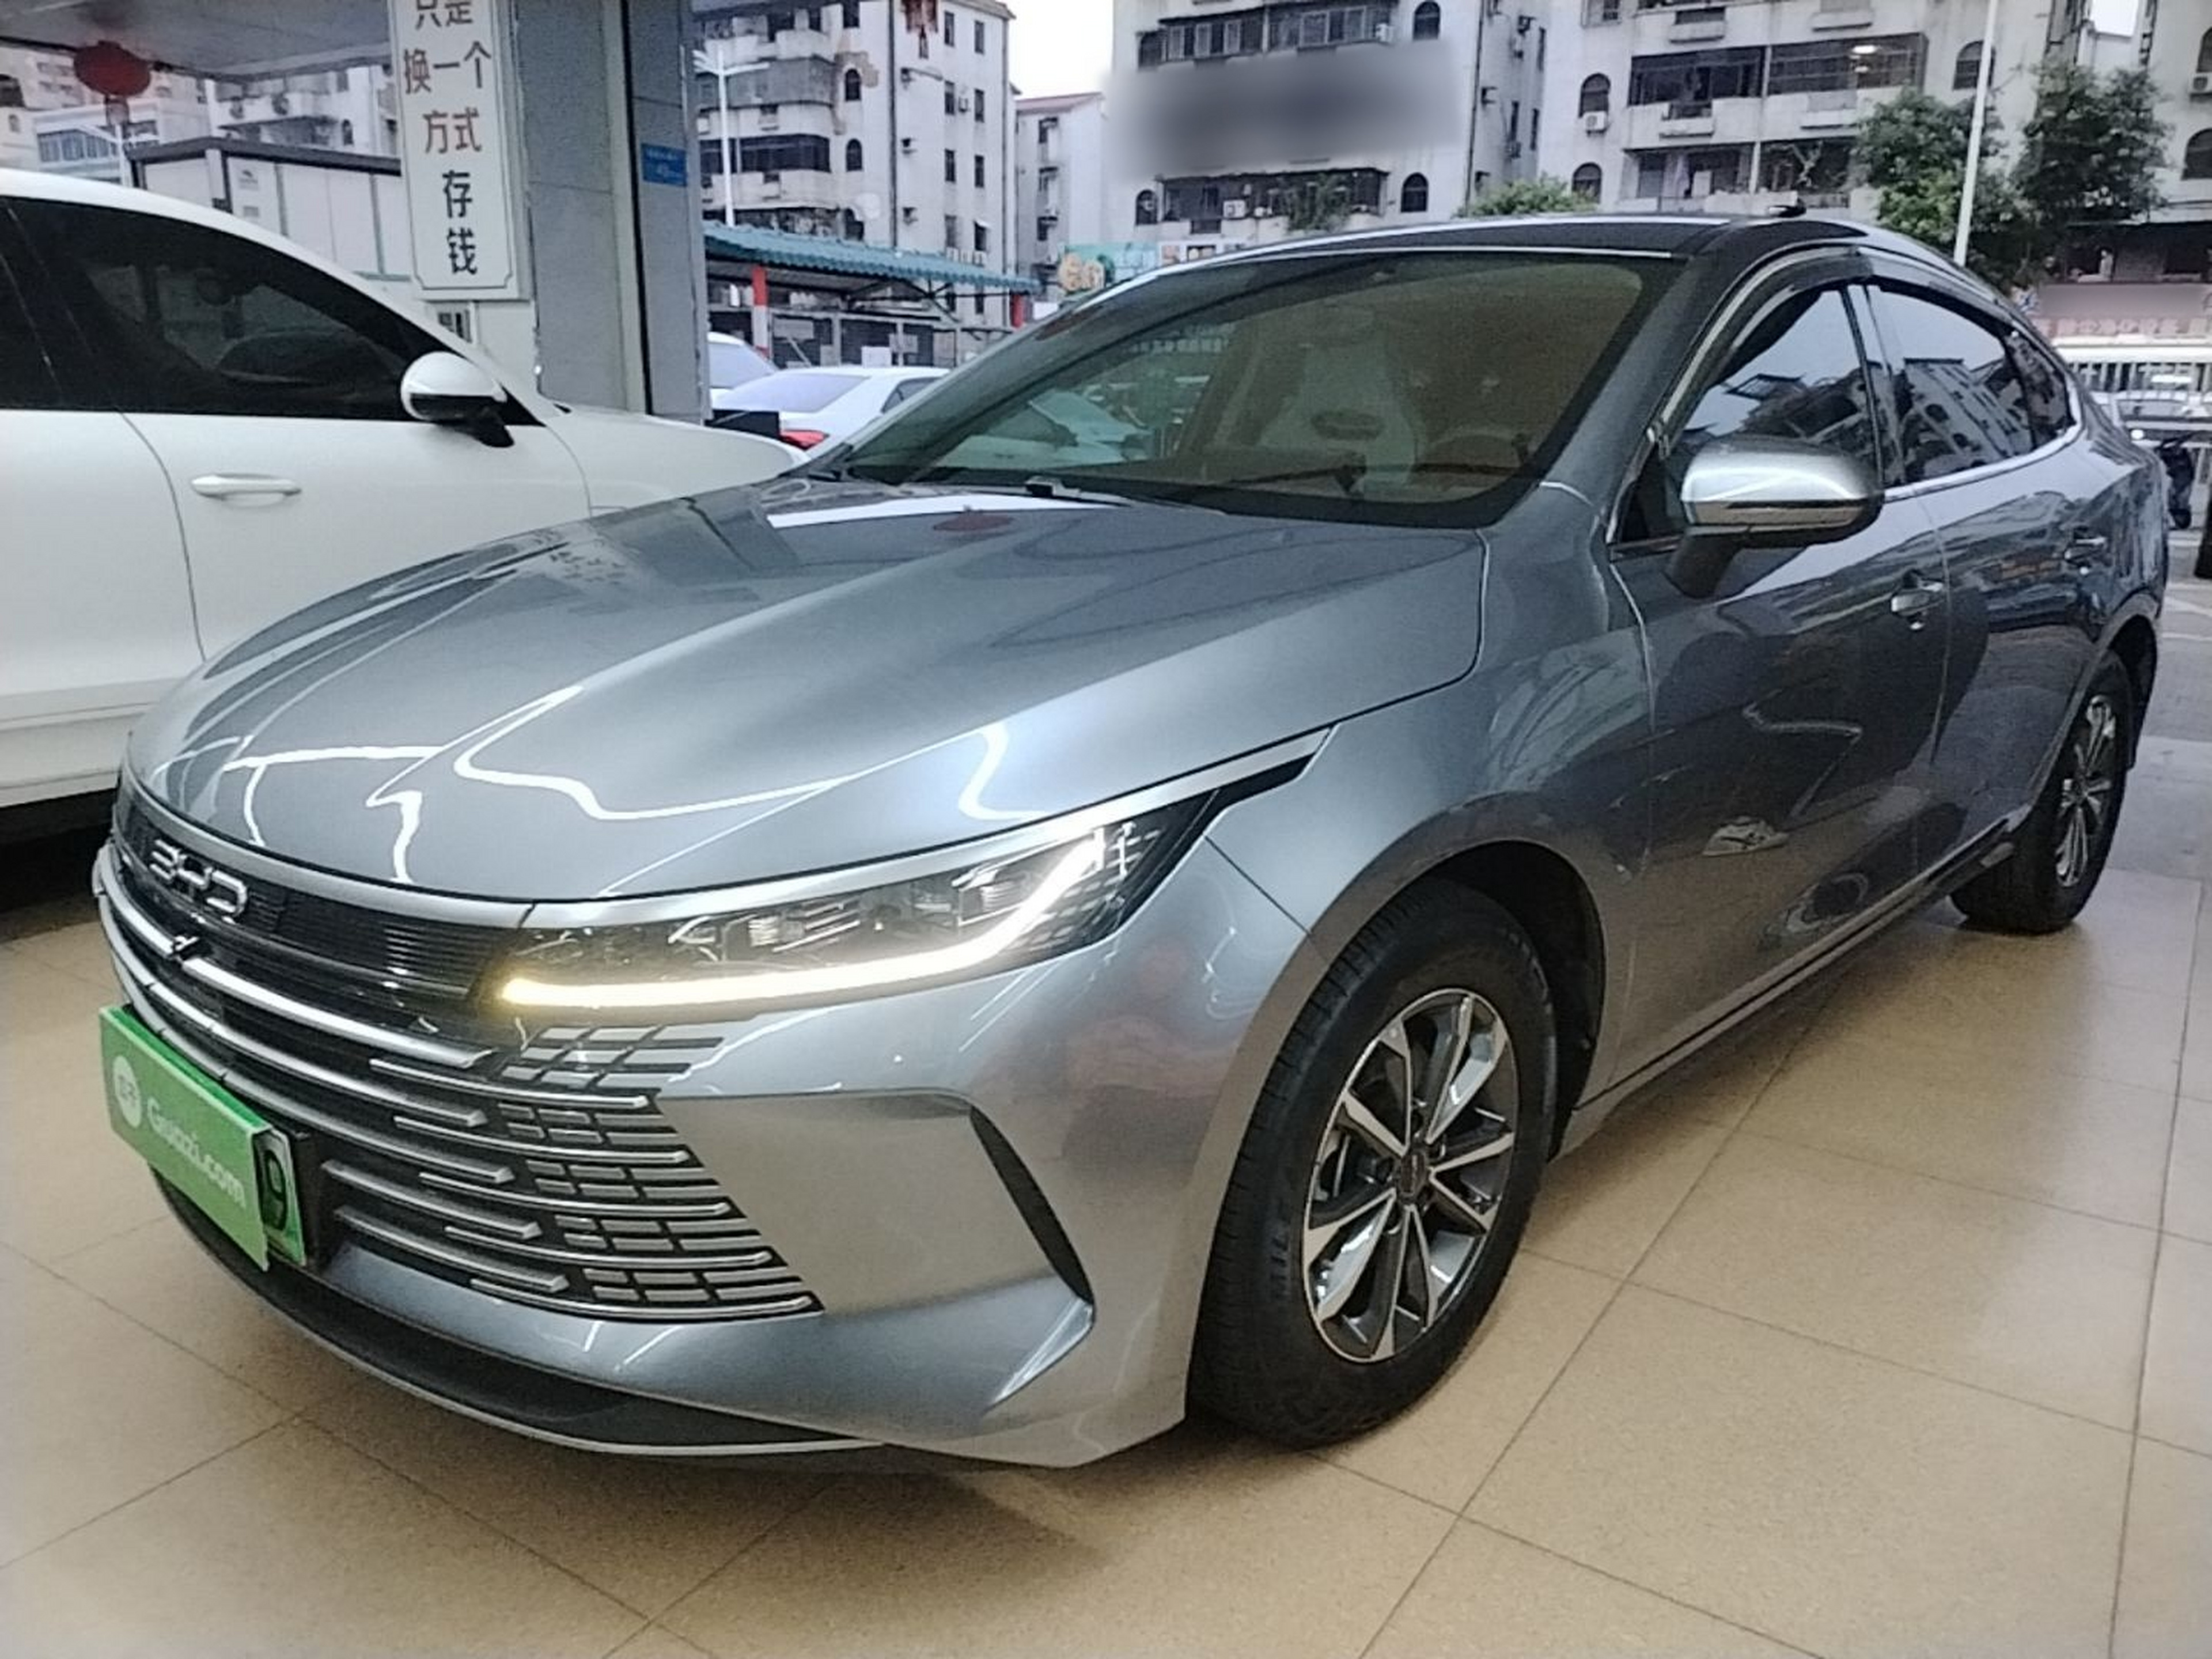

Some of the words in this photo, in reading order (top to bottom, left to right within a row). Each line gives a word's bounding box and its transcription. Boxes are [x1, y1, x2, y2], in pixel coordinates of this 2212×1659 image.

[404, 41, 491, 94] 换一个
[422, 106, 482, 154] 方式
[150, 839, 247, 917] BYD
